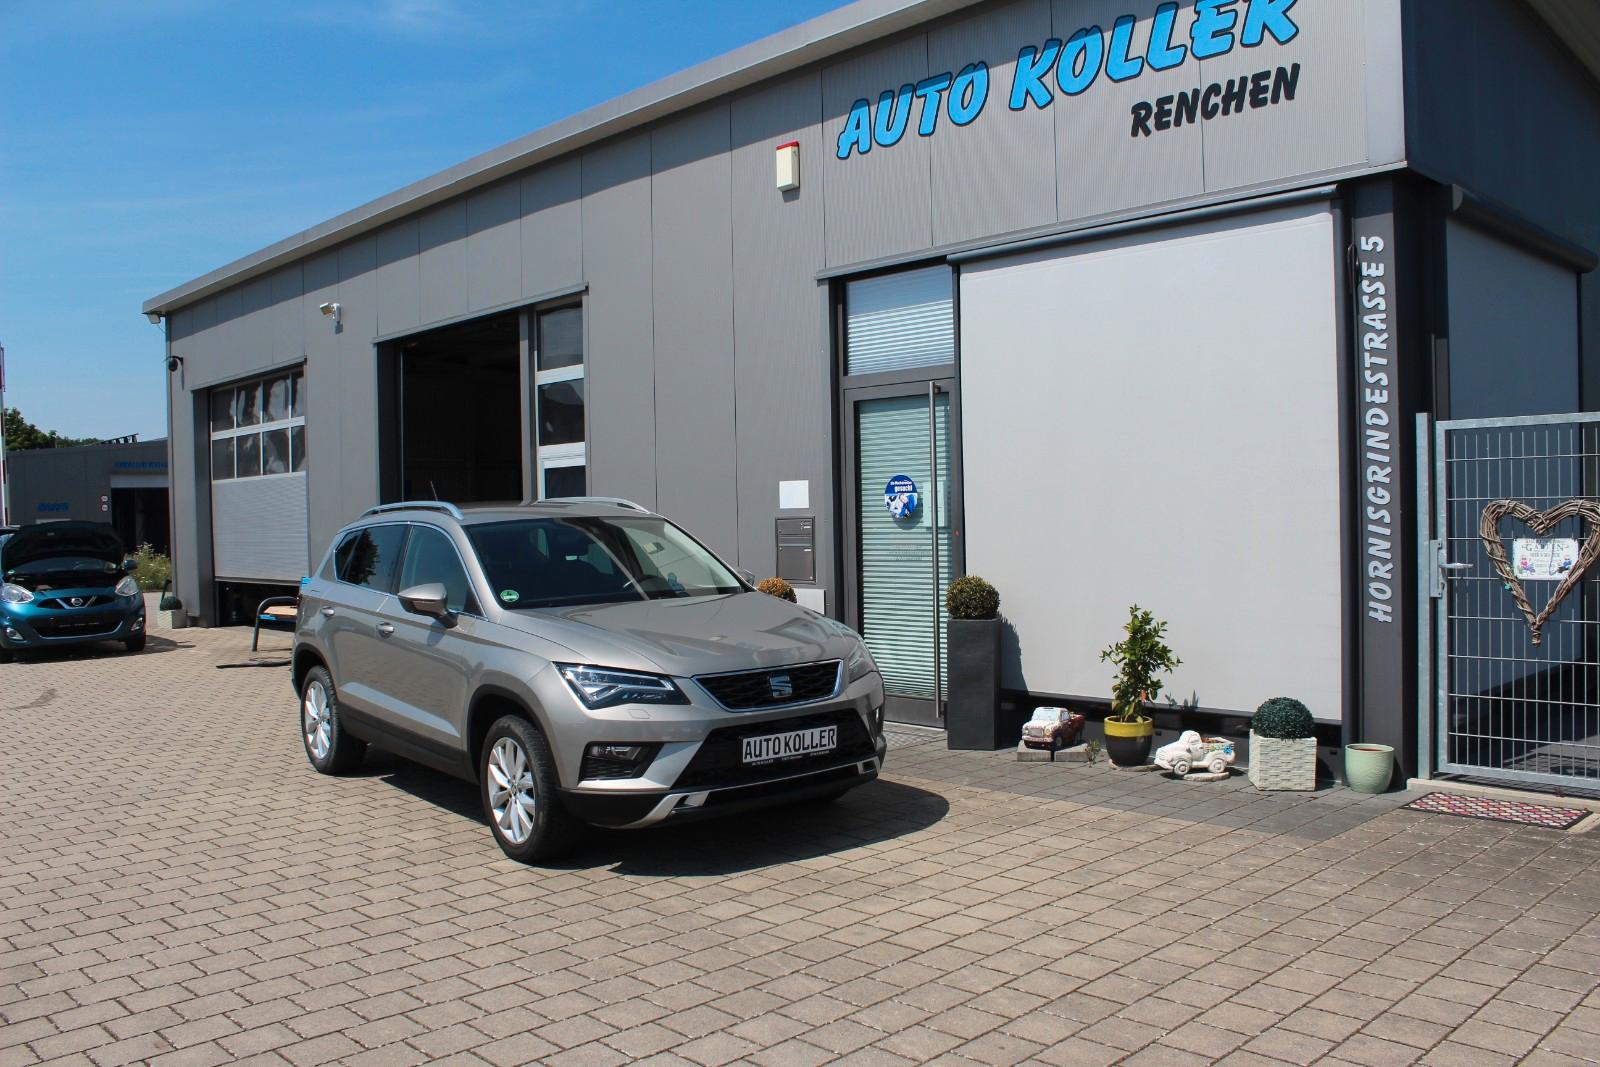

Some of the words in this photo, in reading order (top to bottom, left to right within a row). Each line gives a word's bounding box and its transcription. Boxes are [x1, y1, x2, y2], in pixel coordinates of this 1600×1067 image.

[836, 60, 990, 160] AUTO
[1008, 0, 1300, 111] KOLLER
[1130, 62, 1300, 138] RENCHEN
[1360, 235, 1385, 253] 5
[1361, 261, 1393, 624] HORNISGRINDESTRASSE
[743, 736, 781, 761] AUTO
[784, 728, 836, 754] KOLLER
